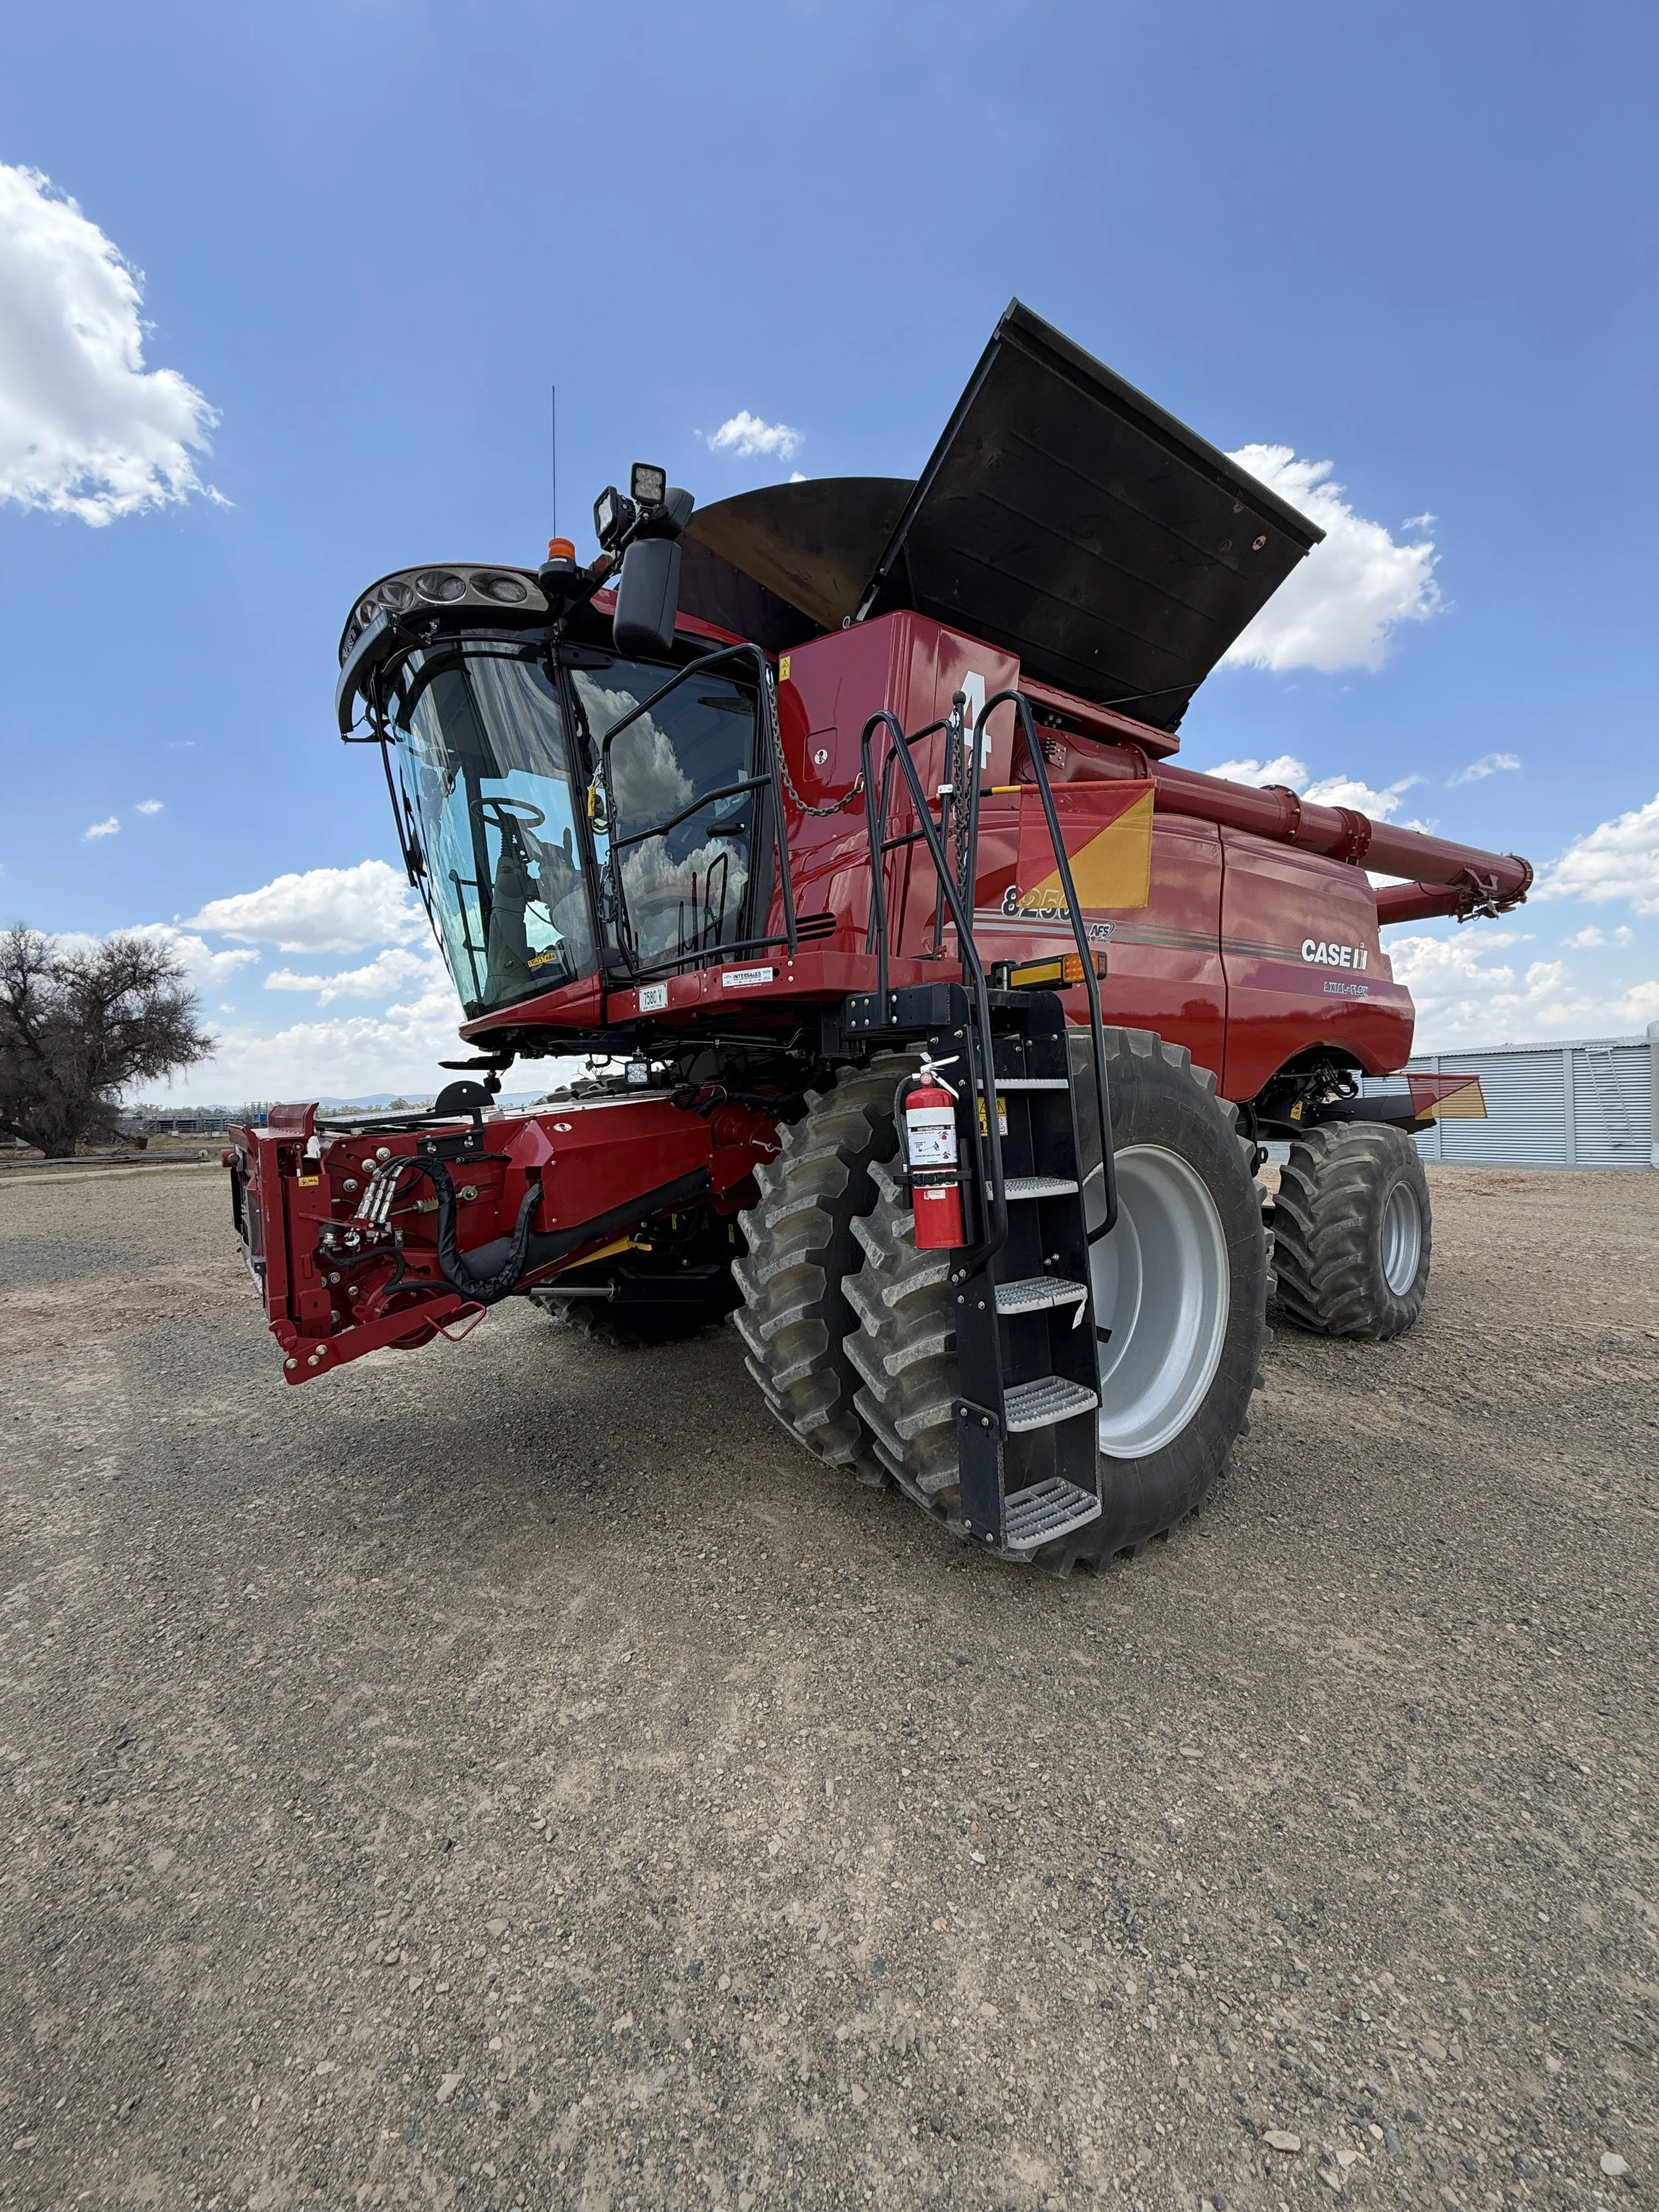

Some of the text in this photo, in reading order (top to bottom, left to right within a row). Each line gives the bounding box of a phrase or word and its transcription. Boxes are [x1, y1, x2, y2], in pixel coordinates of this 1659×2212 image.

[948, 670, 992, 770] 4
[1089, 923, 1111, 937] AFS
[1301, 938, 1352, 968] CASE
[1323, 981, 1370, 996] AXIAL-FLOW
[643, 990, 657, 1006] 7580
